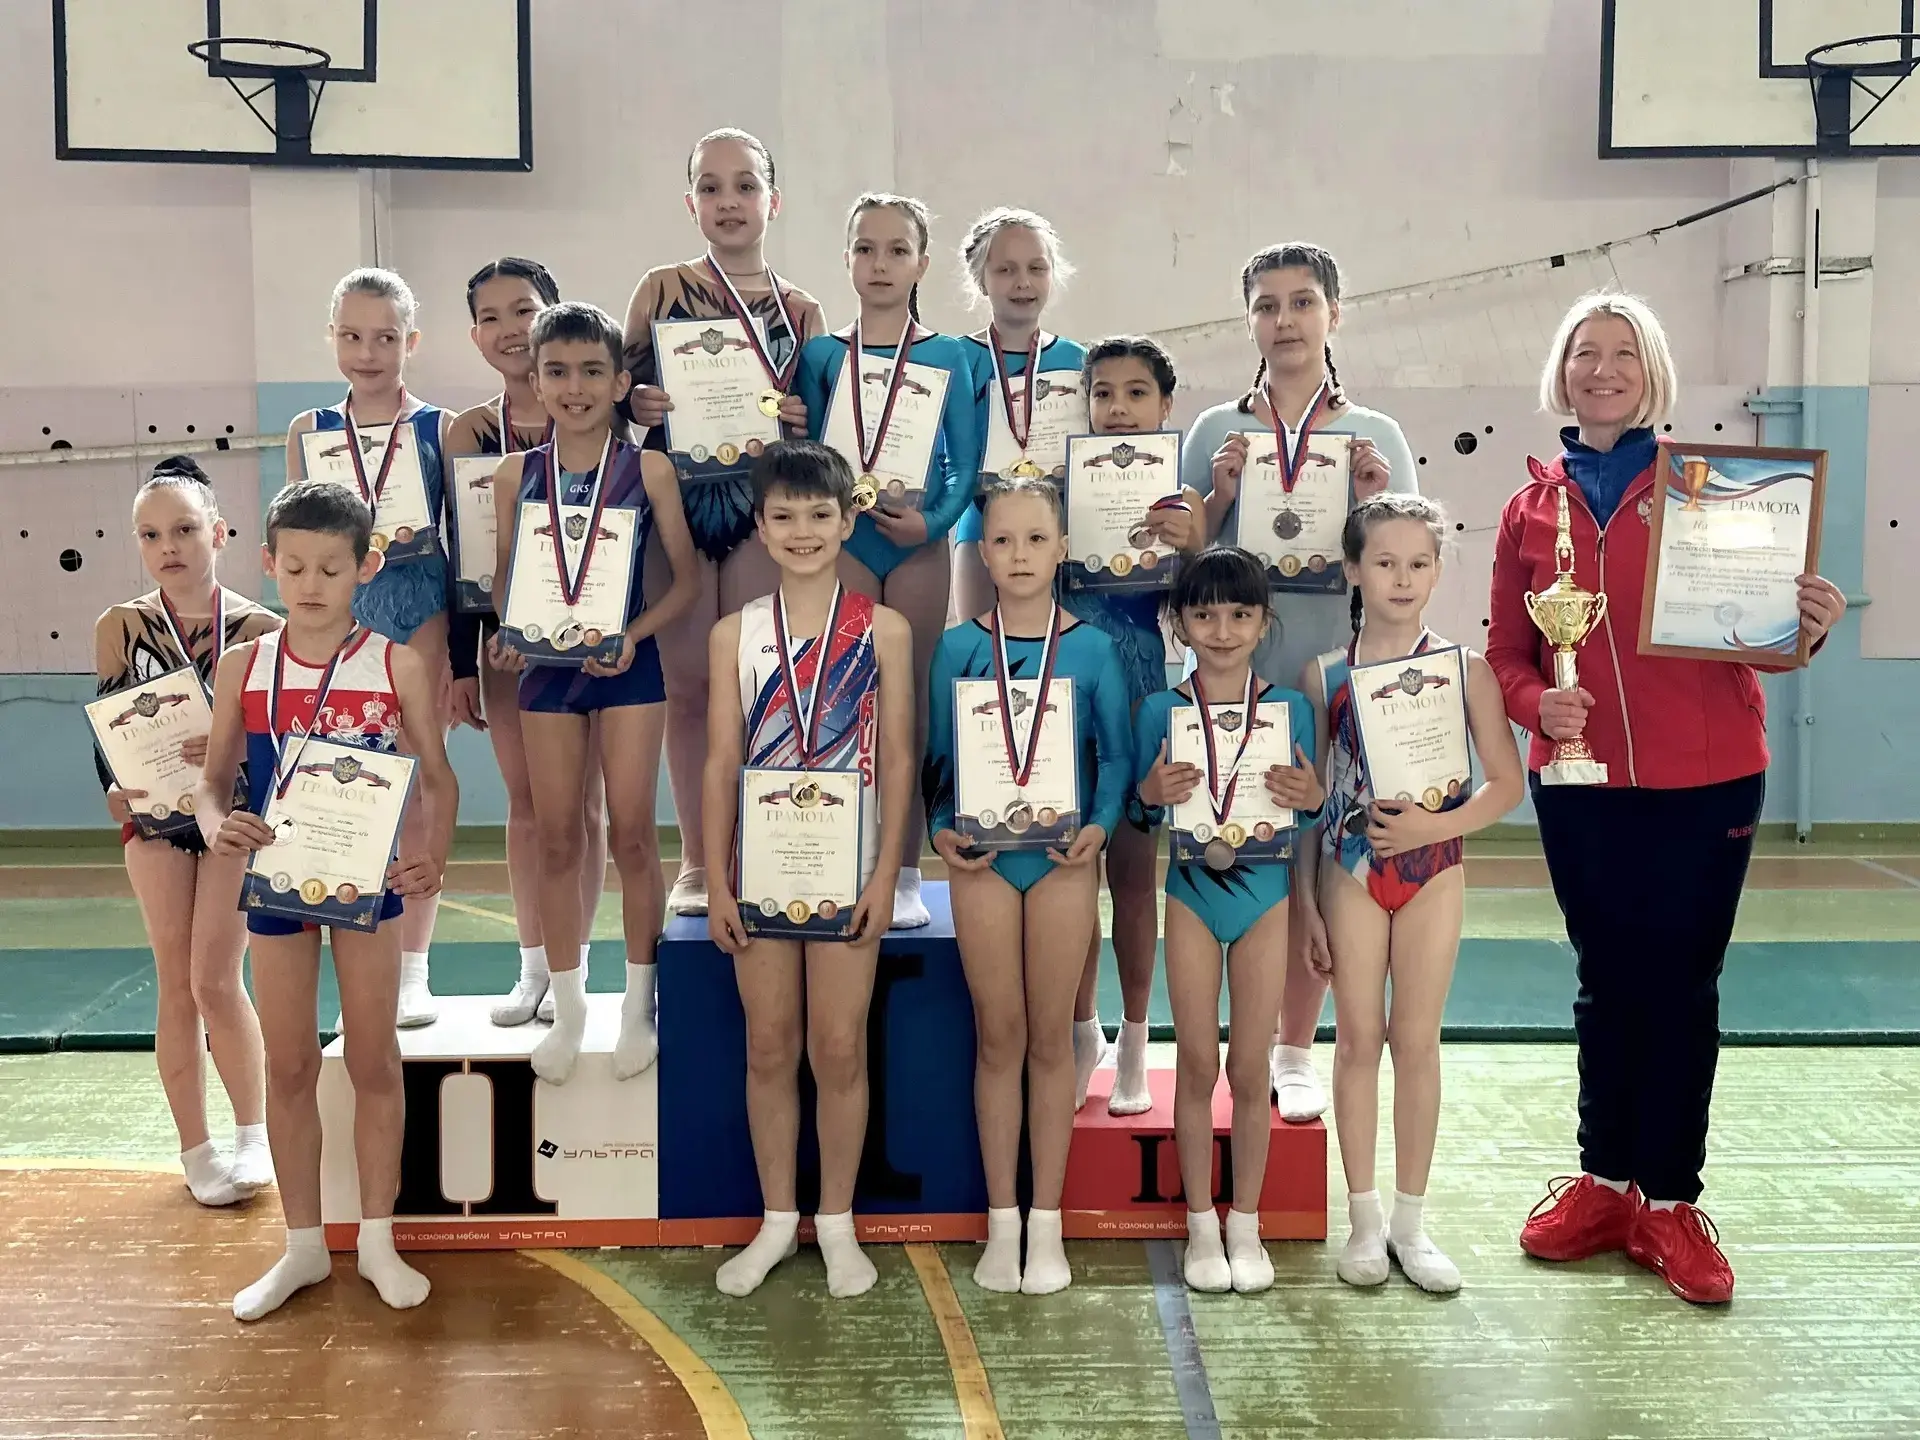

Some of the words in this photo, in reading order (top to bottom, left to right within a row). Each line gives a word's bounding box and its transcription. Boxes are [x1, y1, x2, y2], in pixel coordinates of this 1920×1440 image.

[683, 356, 748, 371] ГРАМОТА
[1090, 470, 1156, 483] ГРАМОТА
[569, 484, 590, 493] GKS
[1729, 500, 1801, 515] ГРАМОТА
[1381, 693, 1447, 716] ГРАМОТА
[121, 709, 189, 741] ГРАМОТА
[301, 780, 377, 804] ГРАМОТА
[766, 810, 836, 823] ГРАМОТА
[563, 1149, 654, 1159] УЛЬТРА
[865, 1225, 932, 1233] УЛЬТРА
[1098, 1222, 1117, 1230] сеть
[1118, 1222, 1154, 1230] салонов
[396, 1233, 415, 1241] сеть
[418, 1232, 454, 1241] салонов
[457, 1230, 490, 1240] мебели
[499, 1231, 567, 1240] УЛЬТРА
